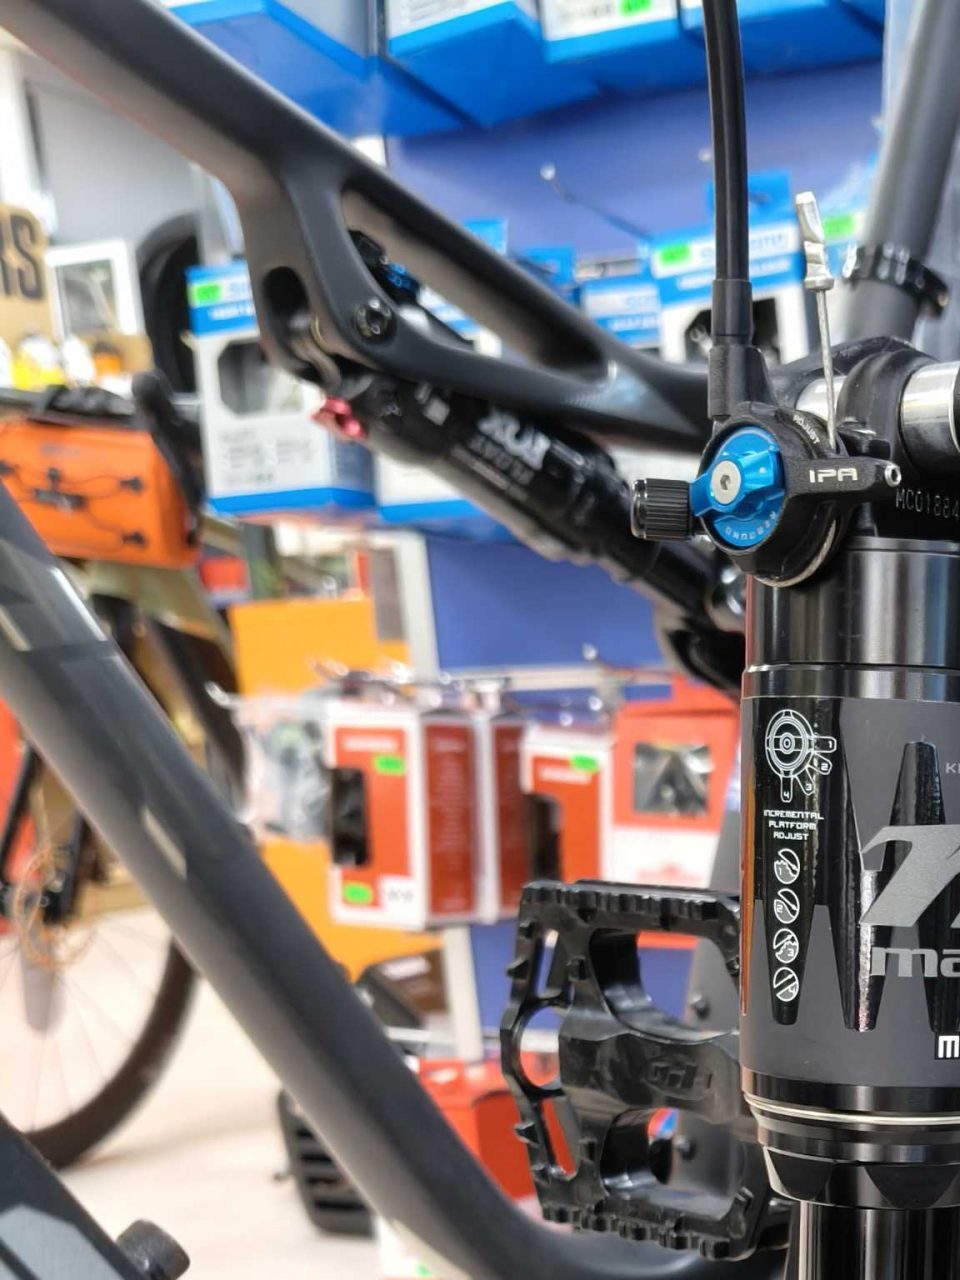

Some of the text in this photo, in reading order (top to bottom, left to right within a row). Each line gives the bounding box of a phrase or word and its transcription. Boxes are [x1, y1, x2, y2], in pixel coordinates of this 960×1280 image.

[792, 414, 821, 445] ADJUST
[809, 467, 859, 484] IPA
[763, 809, 825, 820] INCREMENTAL
[768, 820, 817, 830] PLATFORM
[773, 831, 809, 840] ADJUST
